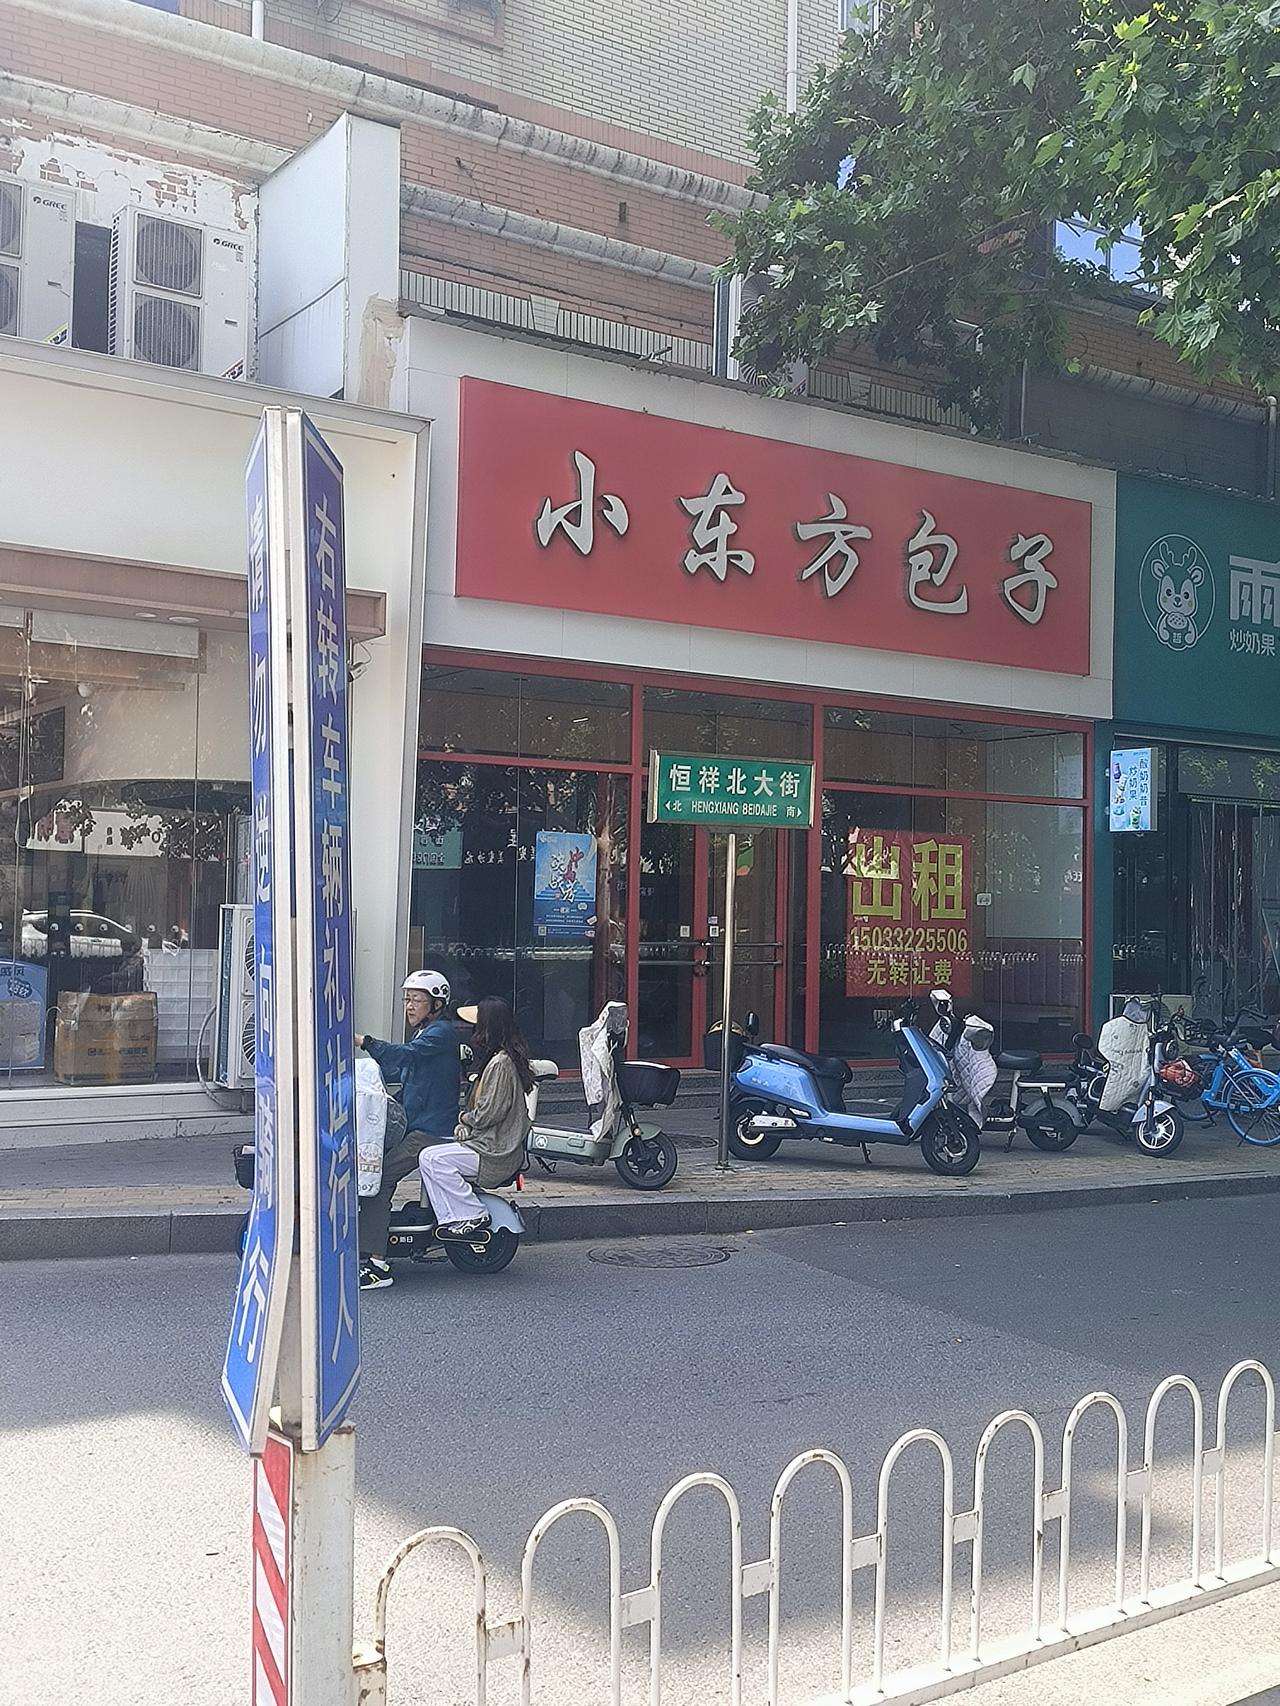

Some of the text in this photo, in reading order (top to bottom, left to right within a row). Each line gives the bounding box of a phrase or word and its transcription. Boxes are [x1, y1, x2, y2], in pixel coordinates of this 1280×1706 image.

[537, 450, 1058, 624] 小东方包子
[1229, 628, 1276, 656] 炒奶果
[669, 763, 801, 798] 恒祥北大街
[672, 800, 796, 818] 北 HENGXIANG BEIDAJIE 南
[852, 836, 967, 921] 出租
[238, 495, 274, 1362] 请勿逆向骑行
[315, 493, 353, 1363] 右转车辆礼让行人
[850, 926, 968, 953] 15033225506
[867, 958, 952, 986] 无转让费
